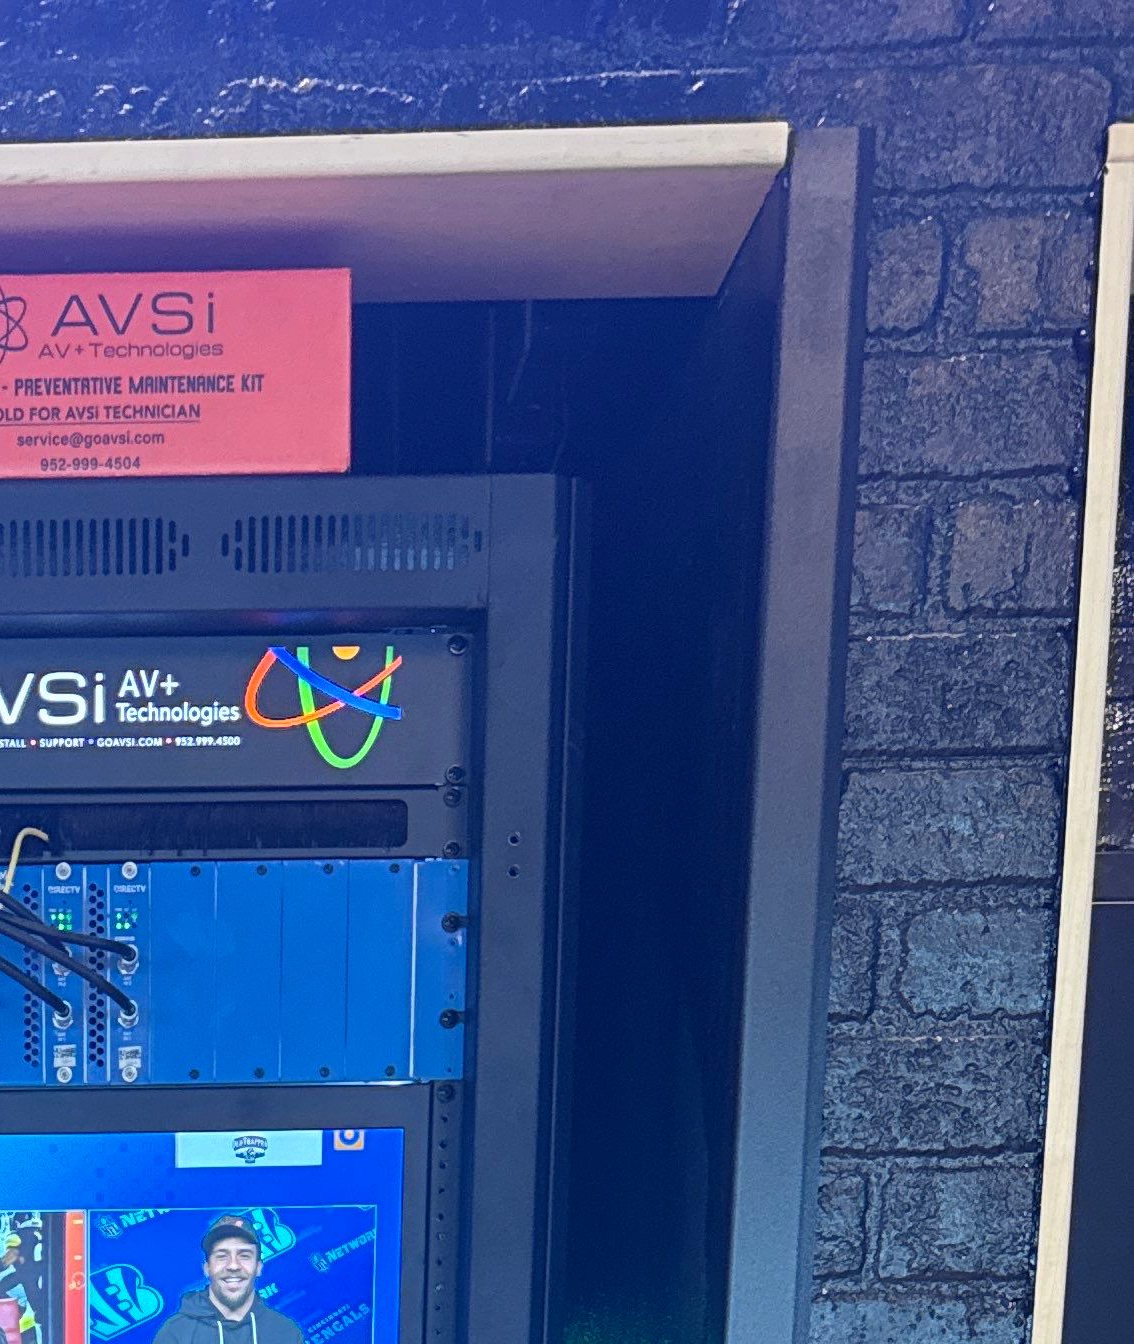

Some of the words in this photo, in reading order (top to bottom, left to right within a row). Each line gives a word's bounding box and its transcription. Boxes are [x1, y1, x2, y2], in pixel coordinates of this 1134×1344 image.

[50, 292, 215, 337] AVSi
[88, 342, 224, 360] Technologies
[14, 376, 123, 397] PREVENTATIVE
[128, 374, 235, 395] MAINTENANCE
[241, 373, 265, 393] KIT
[29, 406, 61, 422] FOR
[103, 403, 201, 420] TECHNICIAN
[17, 431, 166, 450] service@goavsi.com
[40, 456, 142, 472] 952-999-4504
[117, 668, 180, 699] AV+
[115, 700, 242, 727] Technologies
[39, 737, 86, 749] SUPPORT
[96, 736, 164, 748] GOAVSI.COM
[174, 735, 242, 748] 952.999.4500
[47, 885, 81, 895] DIRECTV
[113, 884, 147, 894] DIRECTV
